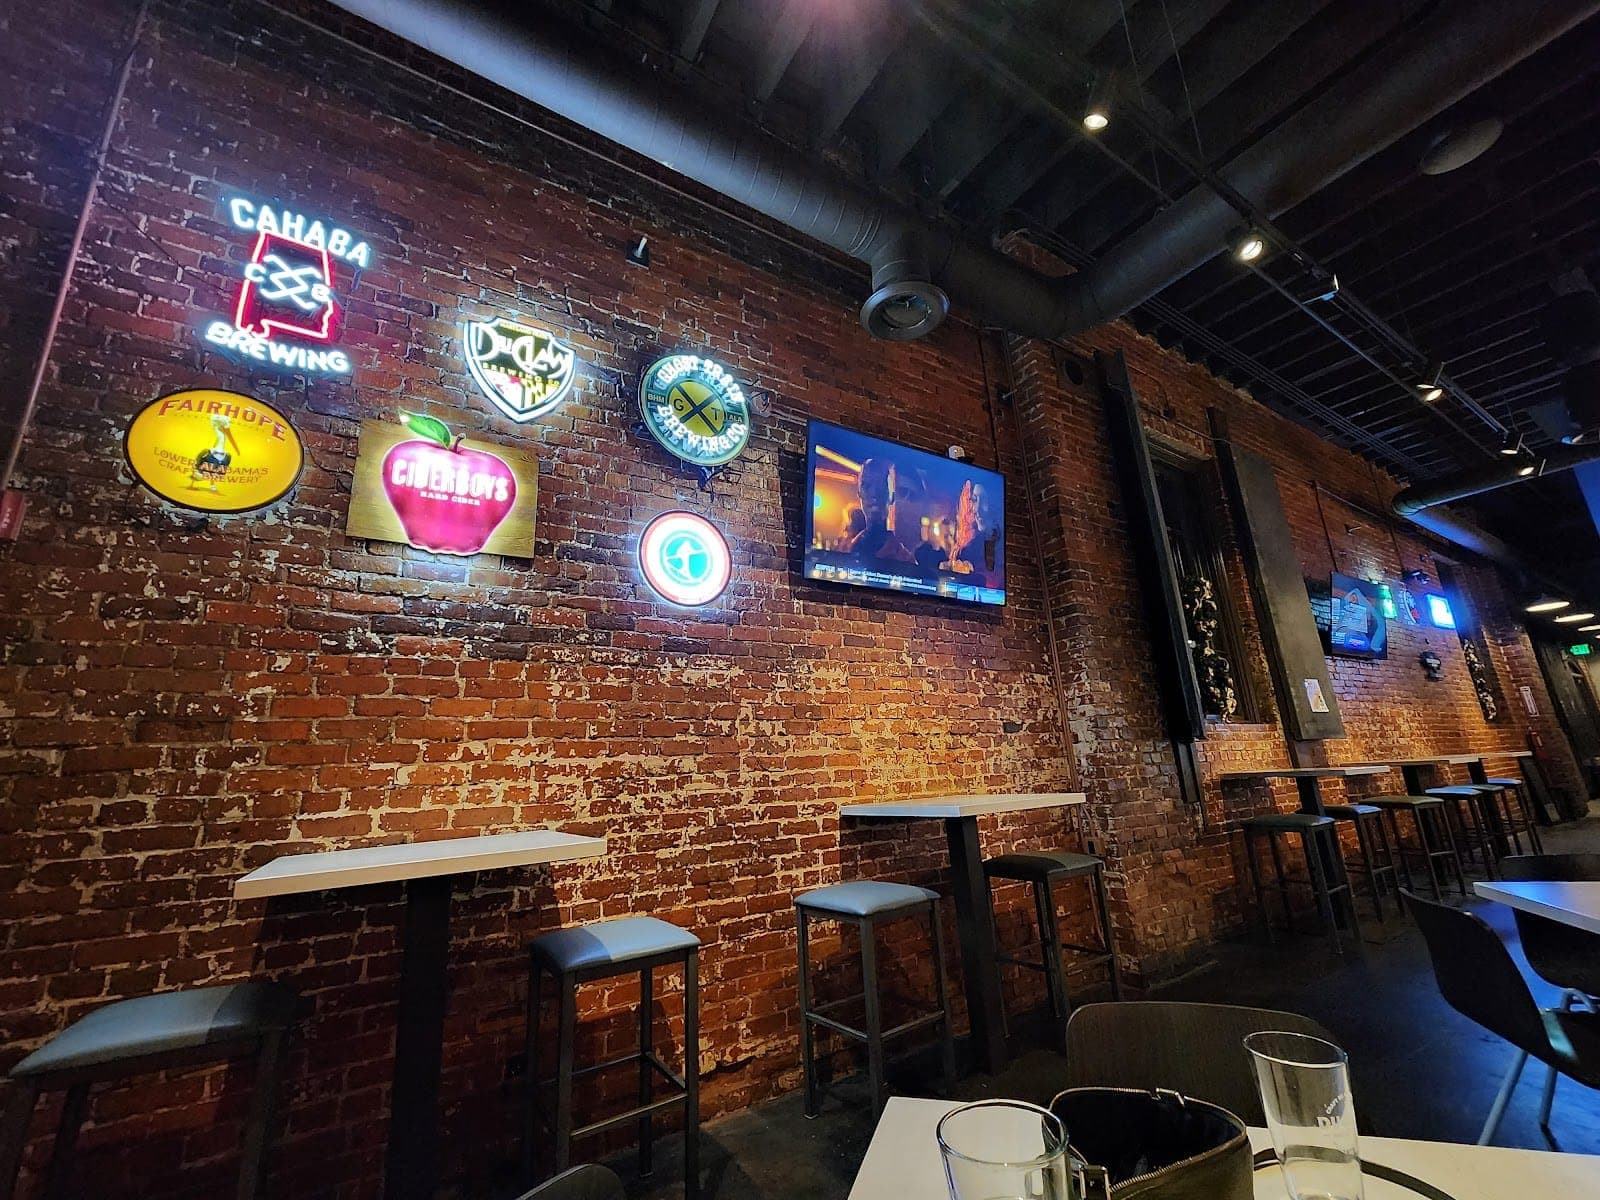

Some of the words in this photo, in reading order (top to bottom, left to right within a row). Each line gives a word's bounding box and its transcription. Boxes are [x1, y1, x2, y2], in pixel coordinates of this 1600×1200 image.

[230, 198, 371, 268] CAHABA
[244, 262, 267, 282] C
[205, 321, 350, 373] BREWING
[647, 393, 665, 403] BHM
[673, 398, 684, 412] G
[710, 407, 720, 421] T
[158, 399, 288, 442] FAIRHOPE
[656, 404, 731, 452] BREWING
[729, 414, 743, 423] ALA
[153, 446, 197, 469] LOWER
[391, 458, 509, 502] CIDERBOYS
[420, 491, 449, 501] HARD
[451, 495, 481, 506] CIDER
